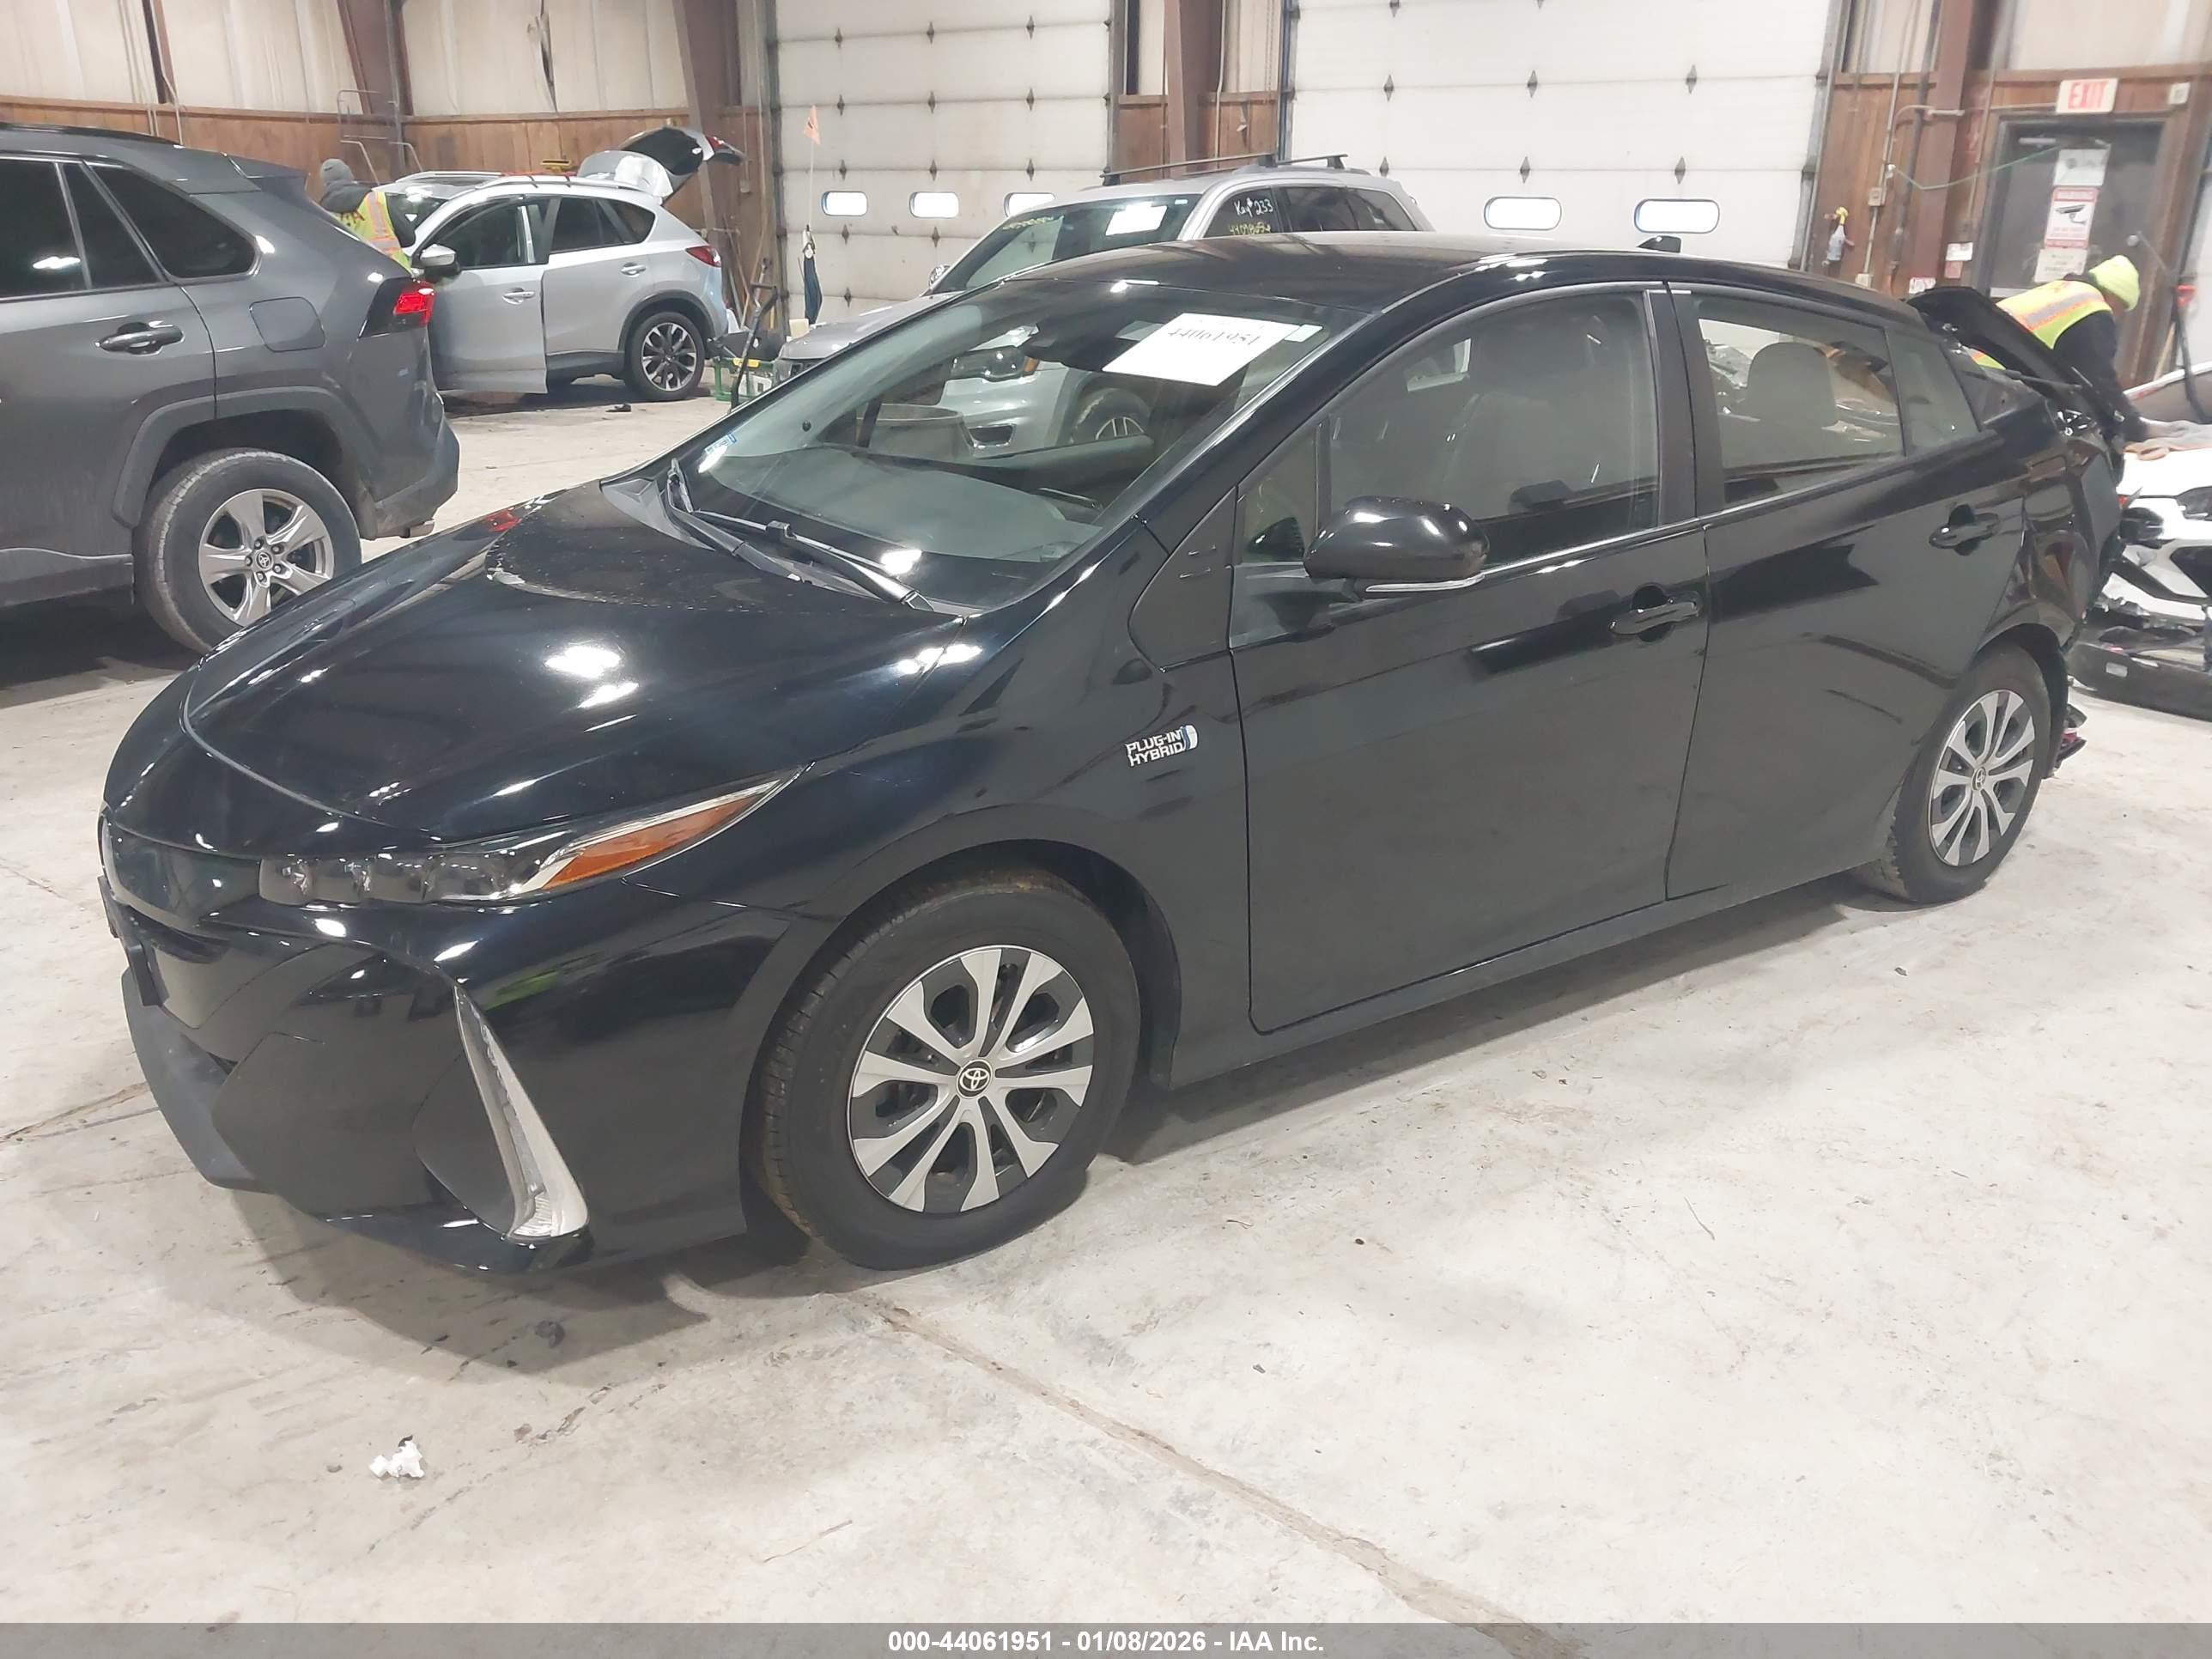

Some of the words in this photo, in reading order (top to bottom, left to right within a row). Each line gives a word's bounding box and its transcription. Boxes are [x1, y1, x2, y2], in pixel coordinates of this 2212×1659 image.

[2067, 82, 2109, 109] EXIT
[1254, 198, 1273, 215] 233
[1124, 726, 1184, 756] PLUG-IN
[1127, 742, 1186, 767] HYBRID
